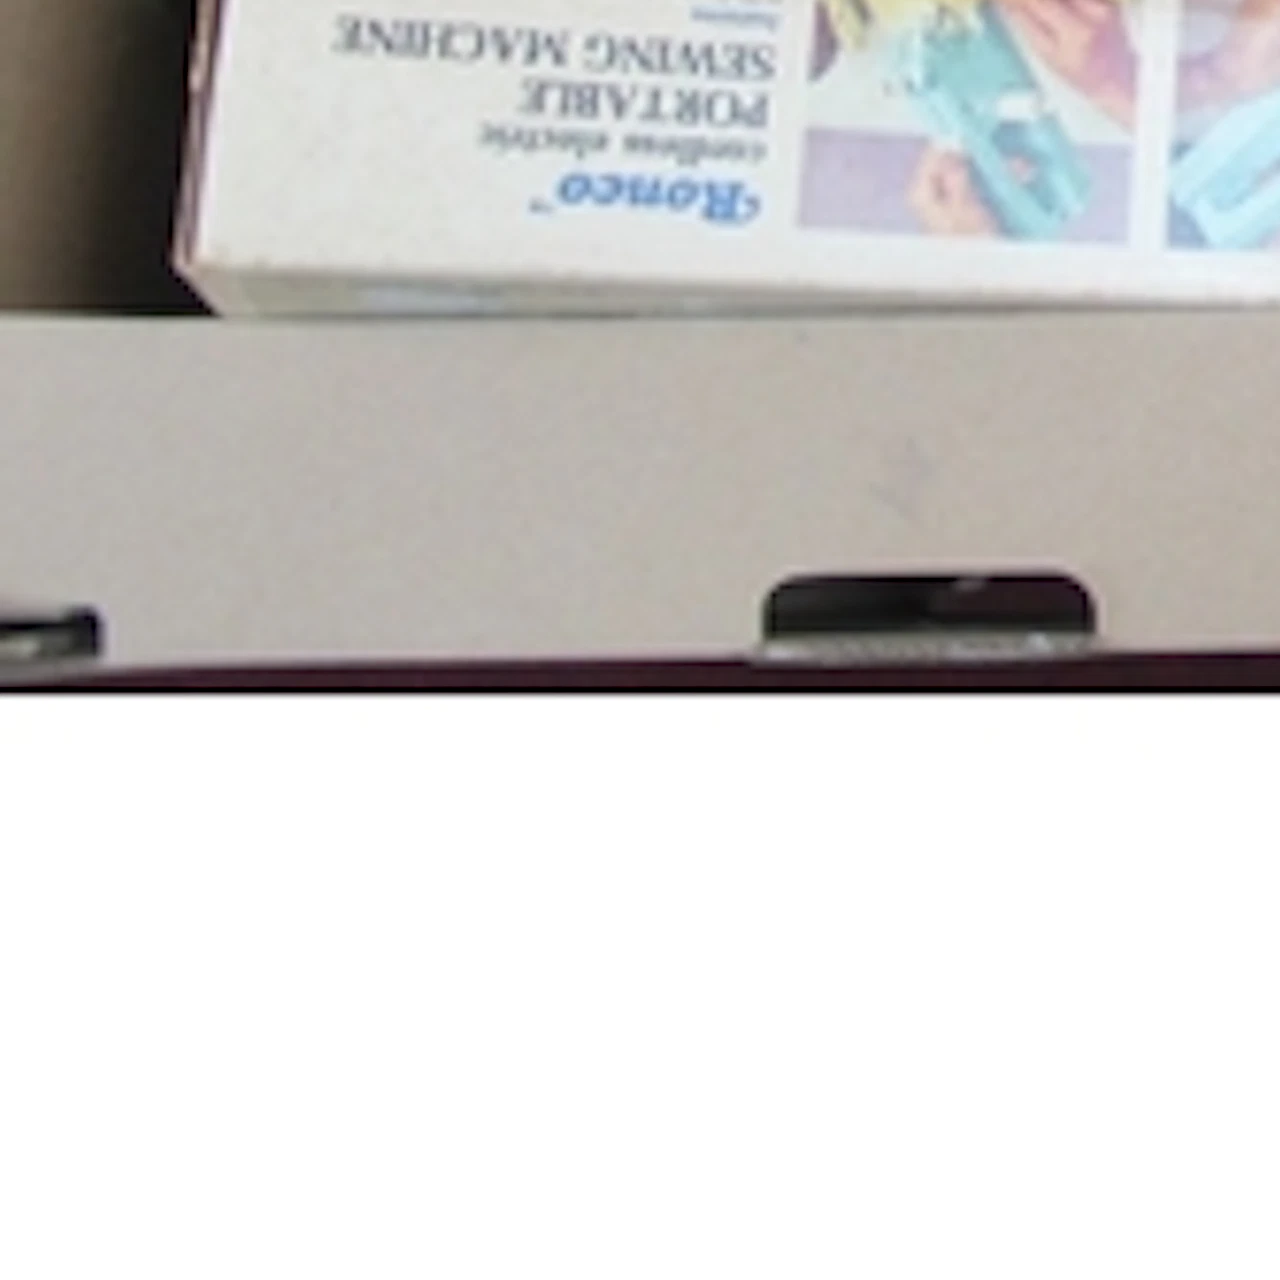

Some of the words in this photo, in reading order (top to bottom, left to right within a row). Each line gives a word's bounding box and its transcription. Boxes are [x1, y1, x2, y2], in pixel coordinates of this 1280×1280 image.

[332, 15, 569, 65] MACHINE
[583, 30, 776, 79] SEWING
[517, 78, 769, 128] PORTABLE
[478, 123, 609, 159] electric
[623, 133, 766, 165] cordless
